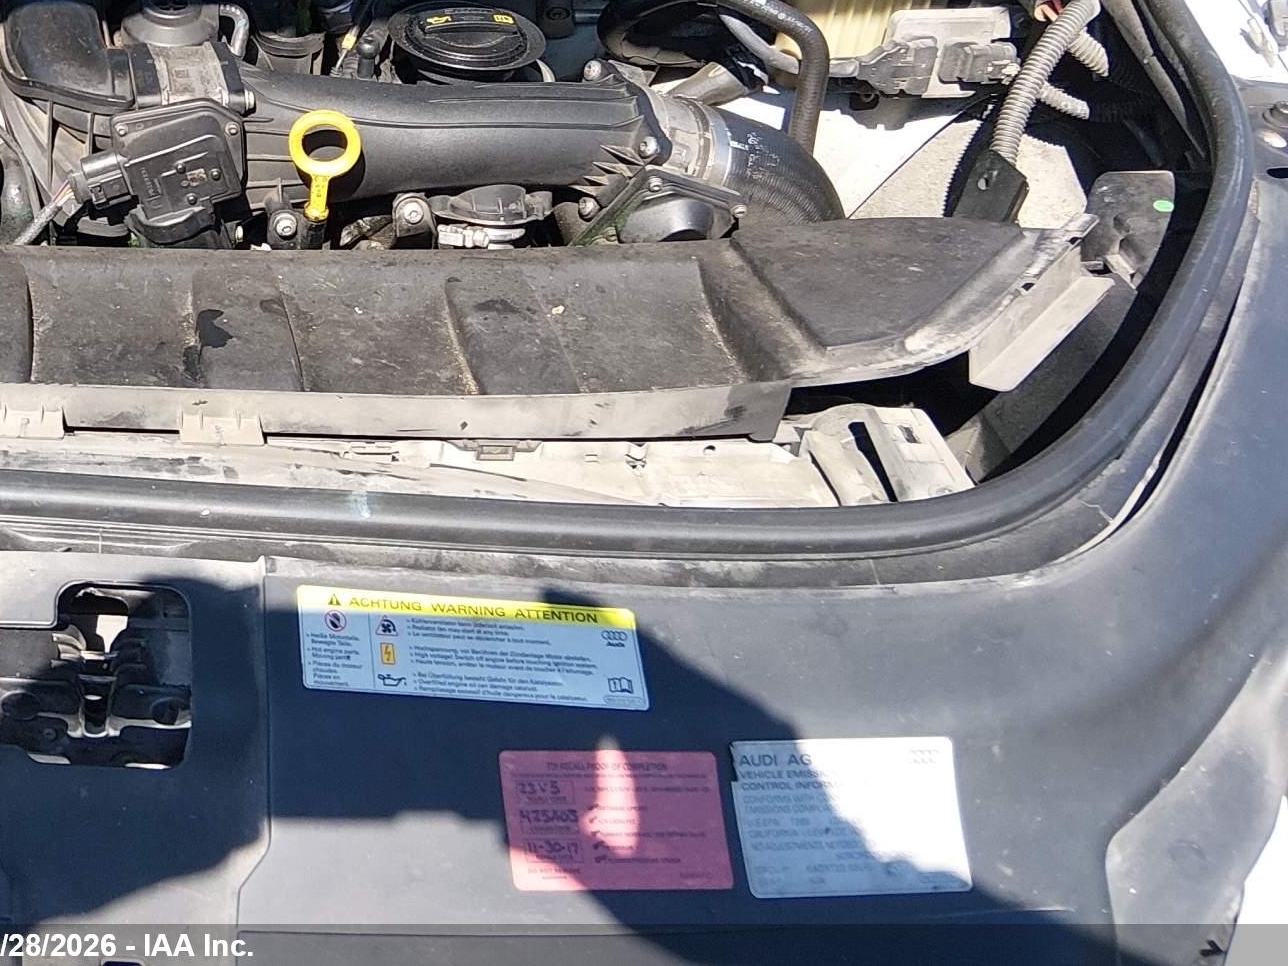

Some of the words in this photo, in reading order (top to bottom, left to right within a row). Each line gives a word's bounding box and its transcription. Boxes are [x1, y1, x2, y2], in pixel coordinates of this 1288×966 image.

[348, 597, 422, 612] ACHTUNG
[430, 603, 506, 618] WARNING
[514, 608, 599, 624] ATTENTION
[739, 754, 778, 766] AUDI
[787, 753, 812, 766] AG
[739, 770, 783, 779] VEHICLE
[742, 781, 792, 791] CONTROL
